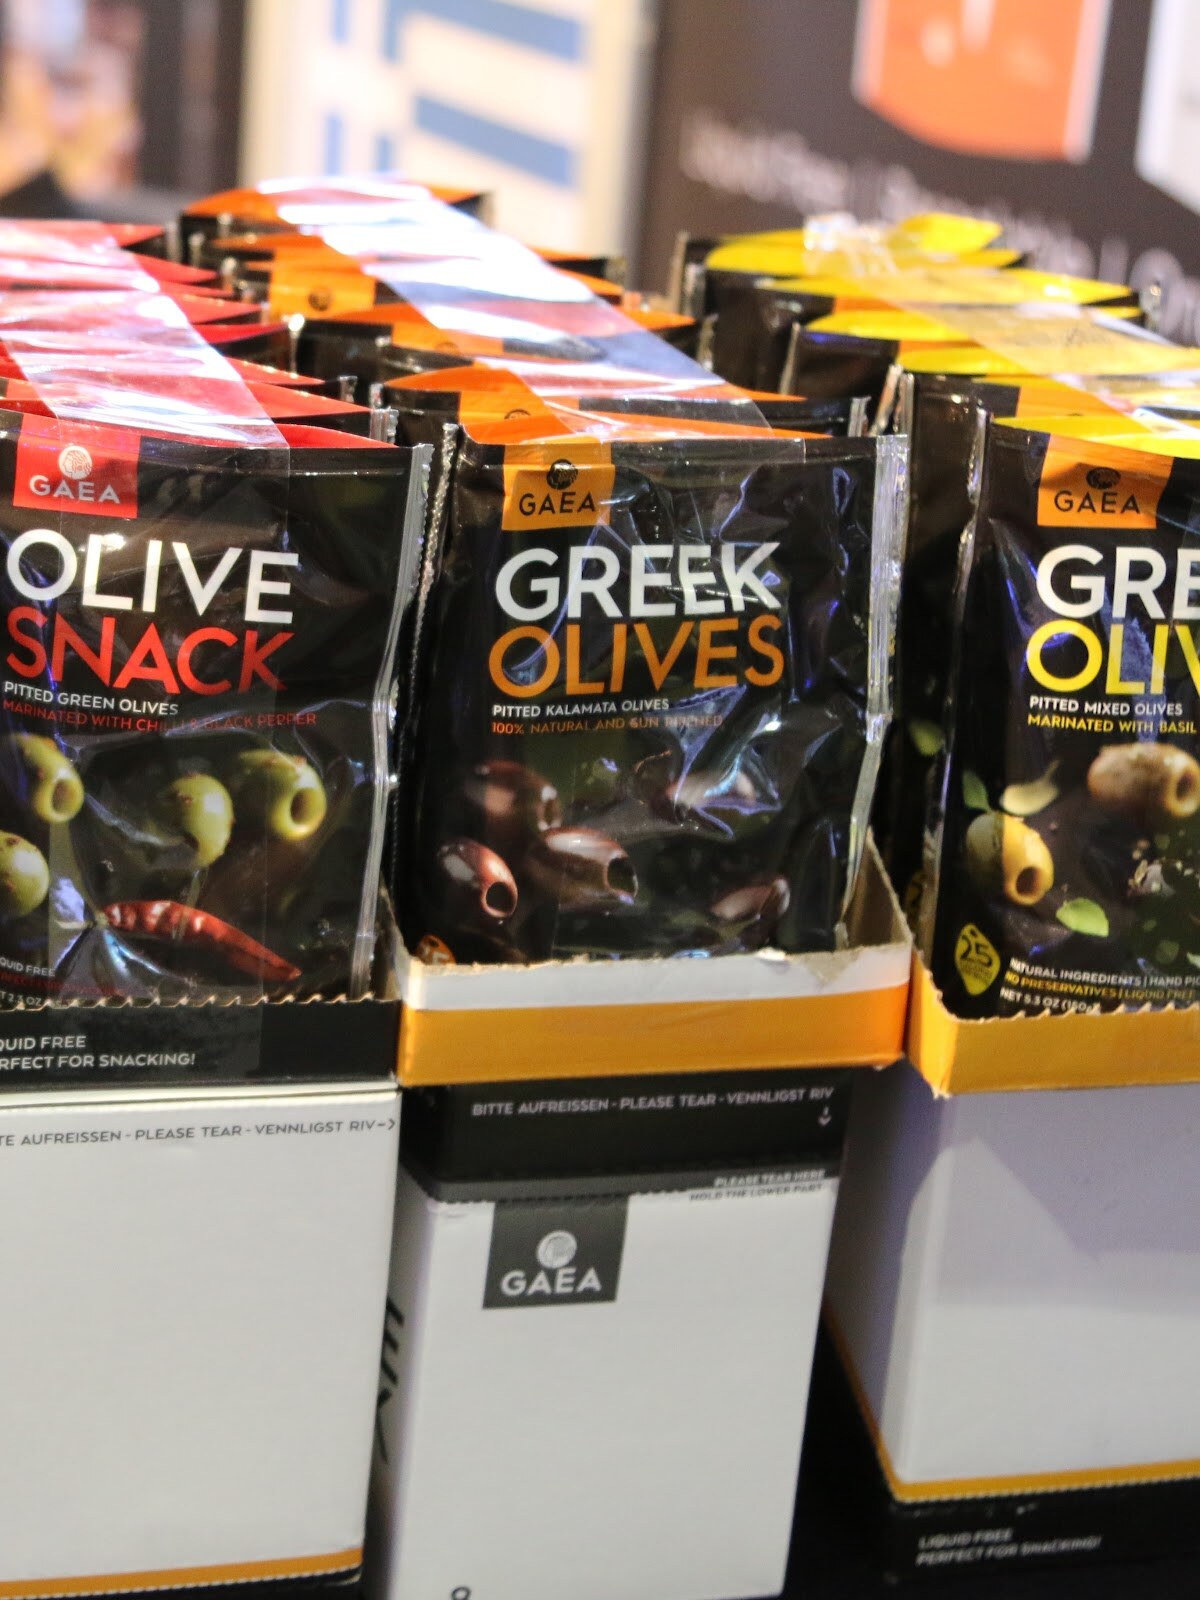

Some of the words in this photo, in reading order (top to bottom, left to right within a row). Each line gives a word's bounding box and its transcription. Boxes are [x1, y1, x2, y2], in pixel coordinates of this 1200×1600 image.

[29, 474, 121, 504] GAEA
[1054, 490, 1140, 514] GAEA
[519, 491, 596, 516] GAEA
[7, 529, 299, 624] OLIVE
[495, 542, 781, 622] GREEK
[5, 606, 295, 696] SNACK
[488, 615, 785, 698] OLIVES
[4, 681, 54, 703] PITTED
[57, 692, 115, 710] GREEN
[120, 698, 179, 715] OLIVES
[492, 704, 541, 718] PITTED
[546, 701, 616, 716] KALAMATA
[621, 699, 670, 712] OLIVES
[1029, 695, 1079, 712] PITTED
[1084, 702, 1130, 715] MIXED
[1134, 703, 1183, 716] OLIVES
[3, 699, 87, 726] MARINATED
[91, 714, 132, 730] WITH
[492, 722, 524, 734] 100%
[531, 720, 589, 733] NATURAL
[594, 718, 625, 731] AND
[1027, 714, 1114, 732] MARINATED
[1119, 721, 1153, 733] WITH
[1159, 721, 1197, 734] BASIL
[26, 965, 56, 977] FREE
[1004, 970, 1020, 985] NO
[1020, 977, 1117, 997] PRESERVATIVES
[1009, 957, 1057, 978] NATURAL
[1060, 969, 1141, 986] INGREDIENTS
[1000, 986, 1022, 1001] NET
[1043, 996, 1060, 1009] OZ
[40, 1036, 86, 1049] FREE
[58, 1054, 94, 1068] FOR
[99, 1053, 196, 1067] SNACKING!
[472, 1103, 514, 1116] BITTE
[518, 1099, 610, 1115] AUFREISSEN
[619, 1095, 674, 1111] PLEASE
[680, 1094, 716, 1107] TEAR
[809, 1087, 834, 1099] RIV
[21, 1131, 121, 1146] AUFREISSEN
[135, 1127, 195, 1141] PLEASE
[201, 1125, 241, 1138] TEAR
[255, 1121, 343, 1136] VENNLIGST
[349, 1120, 377, 1131] RIV
[501, 1267, 602, 1297] GAEA
